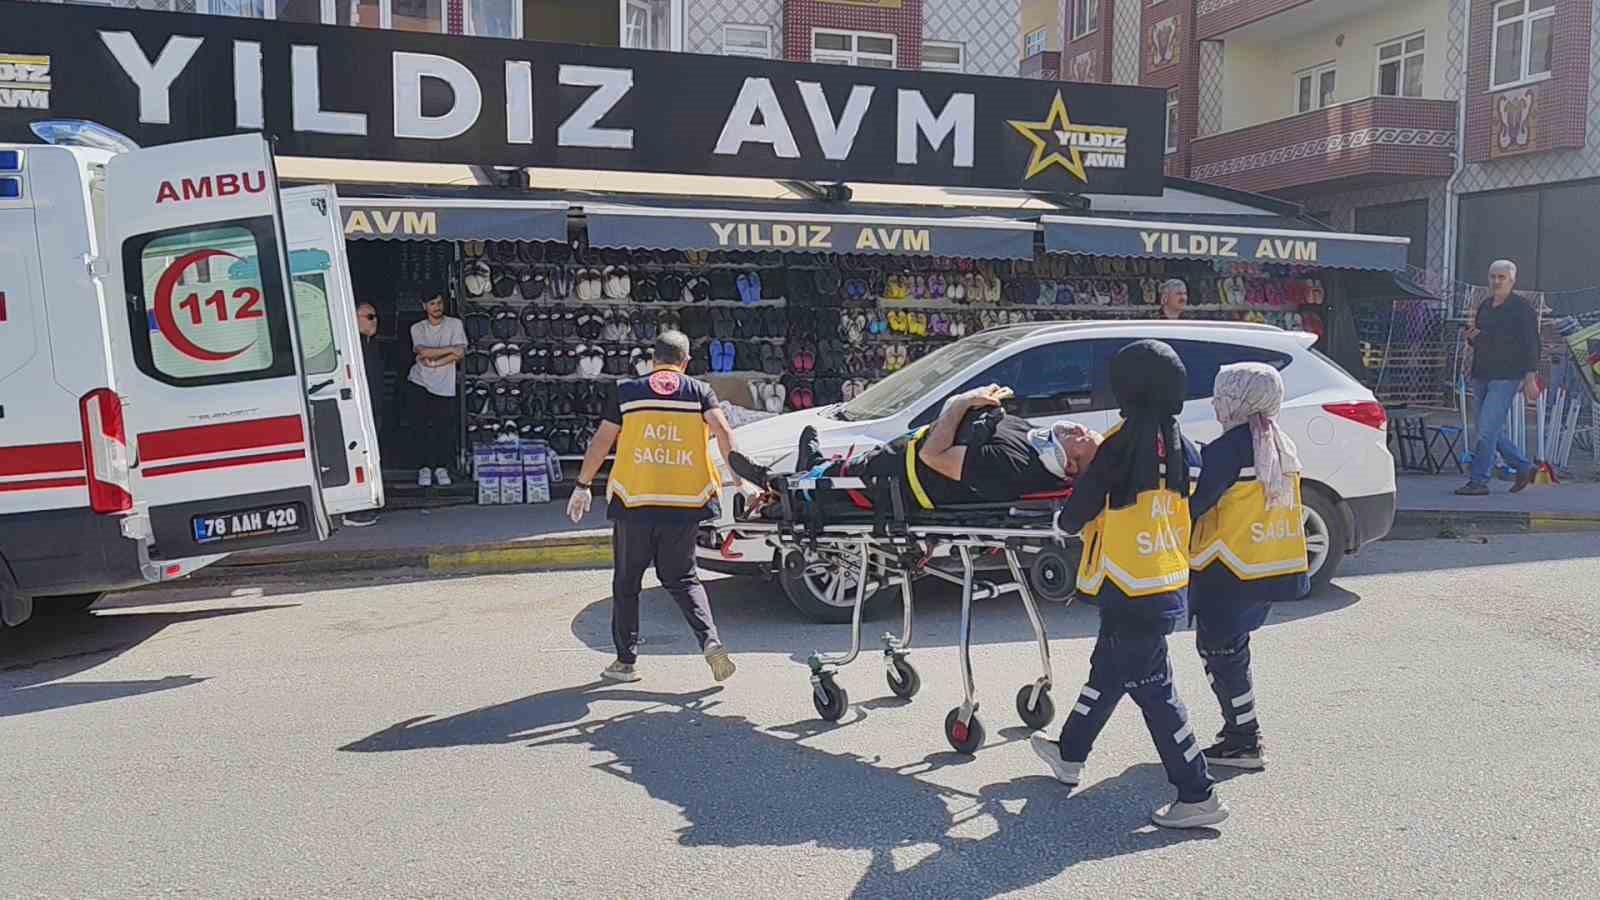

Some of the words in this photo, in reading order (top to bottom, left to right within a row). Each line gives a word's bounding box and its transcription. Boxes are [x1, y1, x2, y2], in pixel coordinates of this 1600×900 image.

[99, 31, 634, 149] YILDIZ
[713, 77, 976, 168] AVM
[1054, 130, 1127, 148] YILDIZ
[1084, 152, 1126, 168] AVM
[155, 170, 266, 204] AMBU
[344, 210, 437, 234] AVM
[710, 222, 833, 248] YILDIZ
[855, 227, 931, 252] AVM
[1140, 231, 1238, 257] YILDIZ
[1255, 239, 1318, 261] AVM
[179, 286, 264, 325] 112
[204, 518, 226, 537] 78
[231, 512, 262, 533] AAH
[266, 507, 297, 528] 420
